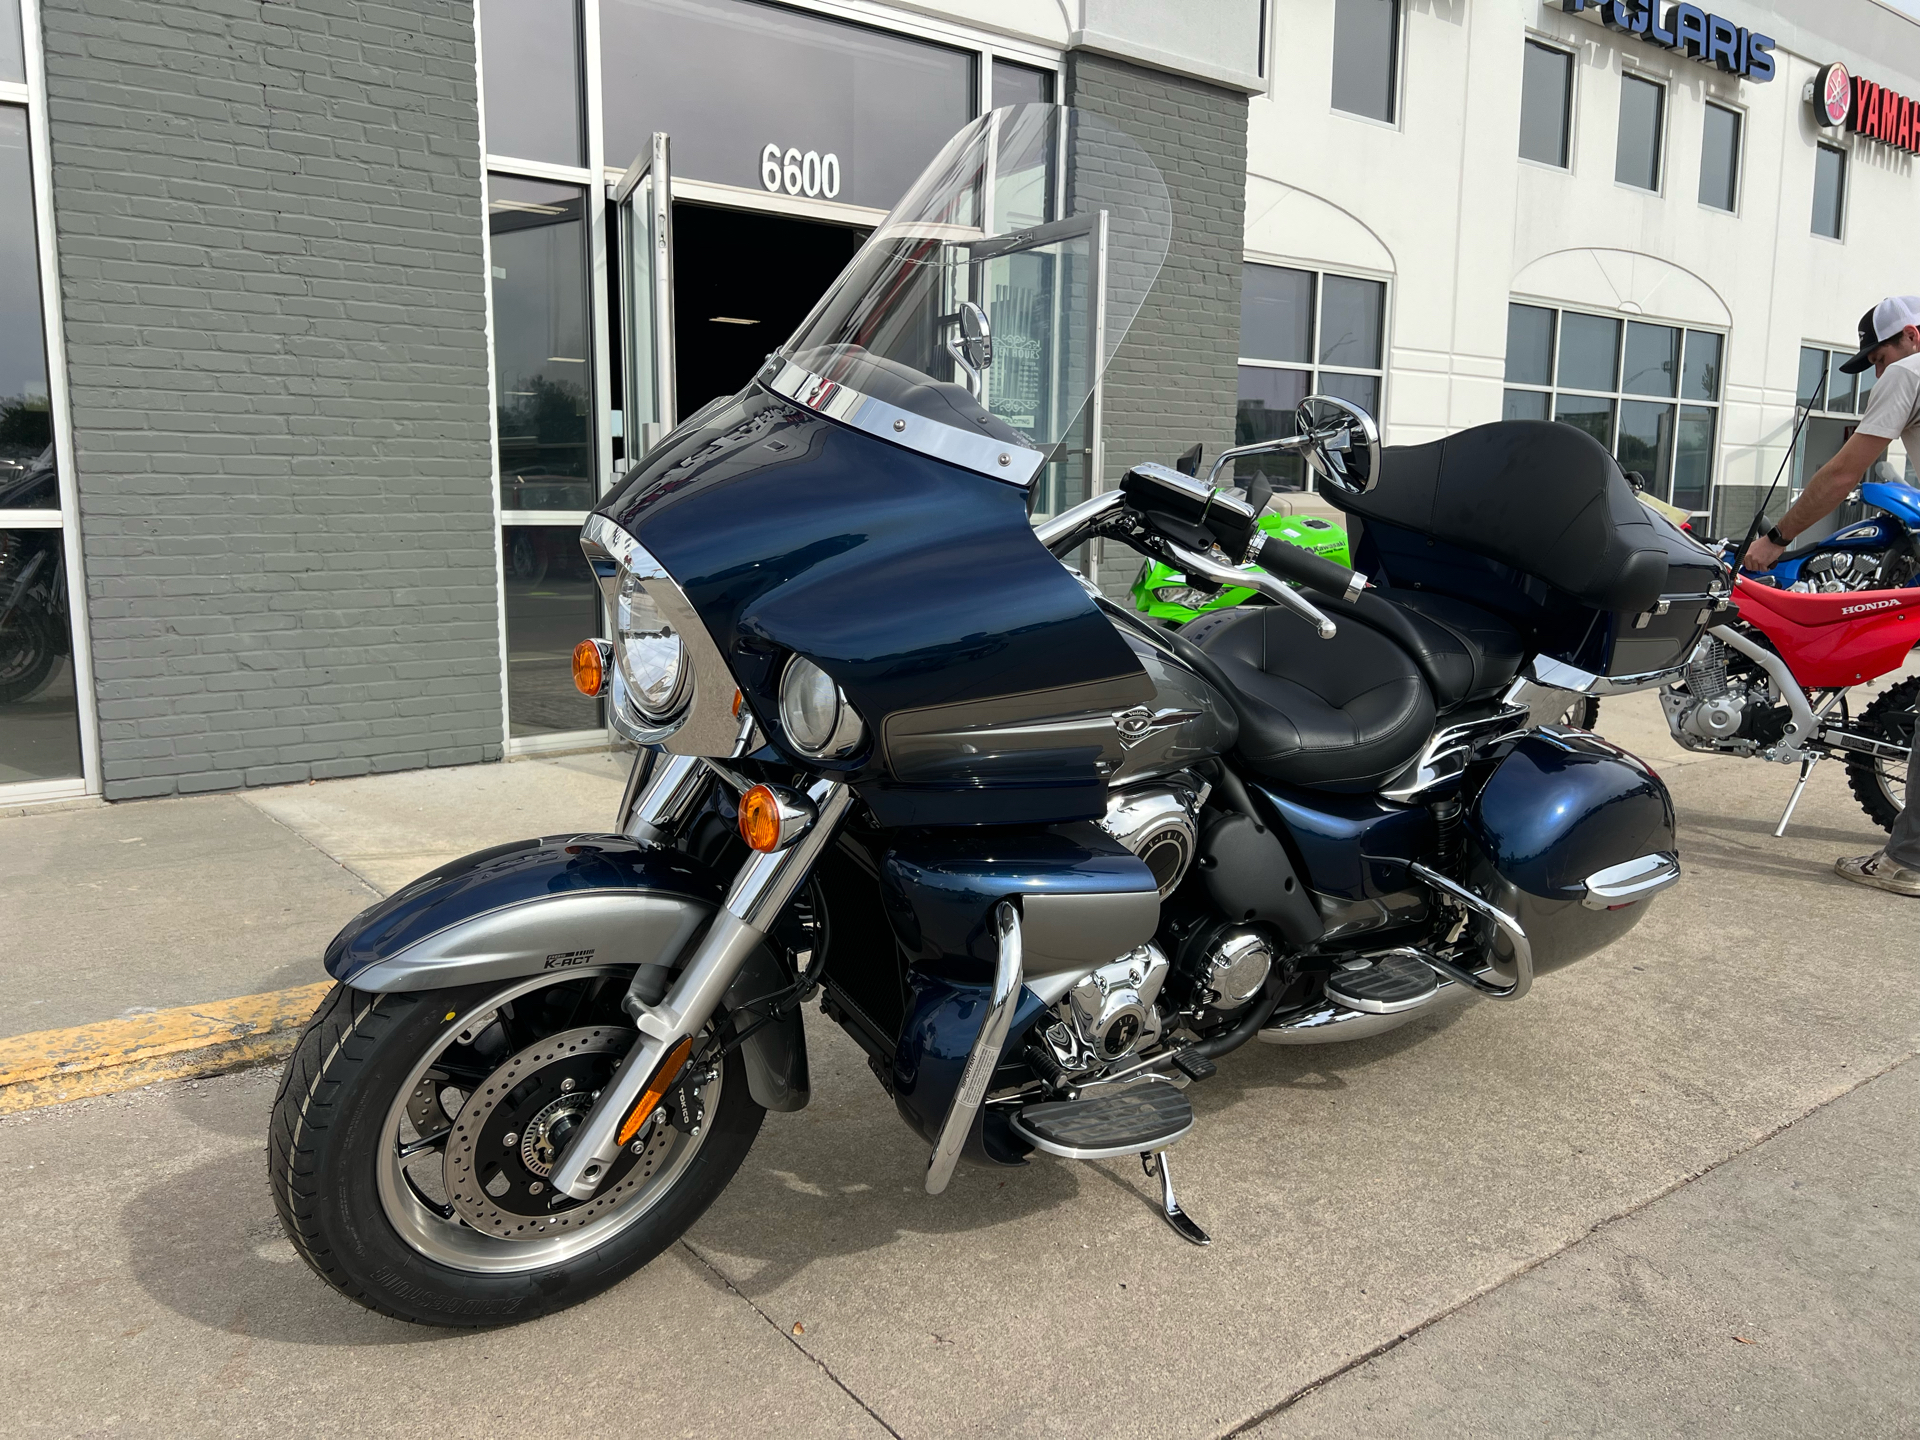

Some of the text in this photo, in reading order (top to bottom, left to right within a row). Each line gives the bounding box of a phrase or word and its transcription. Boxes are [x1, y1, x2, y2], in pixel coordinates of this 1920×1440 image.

[1574, 0, 1775, 82] OLARIS
[761, 143, 840, 199] 6600
[1012, 348, 1040, 360] HOURS
[1313, 540, 1346, 553] Kawasaki
[1841, 598, 1902, 615] HONDA
[543, 955, 594, 969] K-ACT
[961, 1054, 977, 1089] IMPORTANT
[678, 1087, 690, 1124] TOKICO
